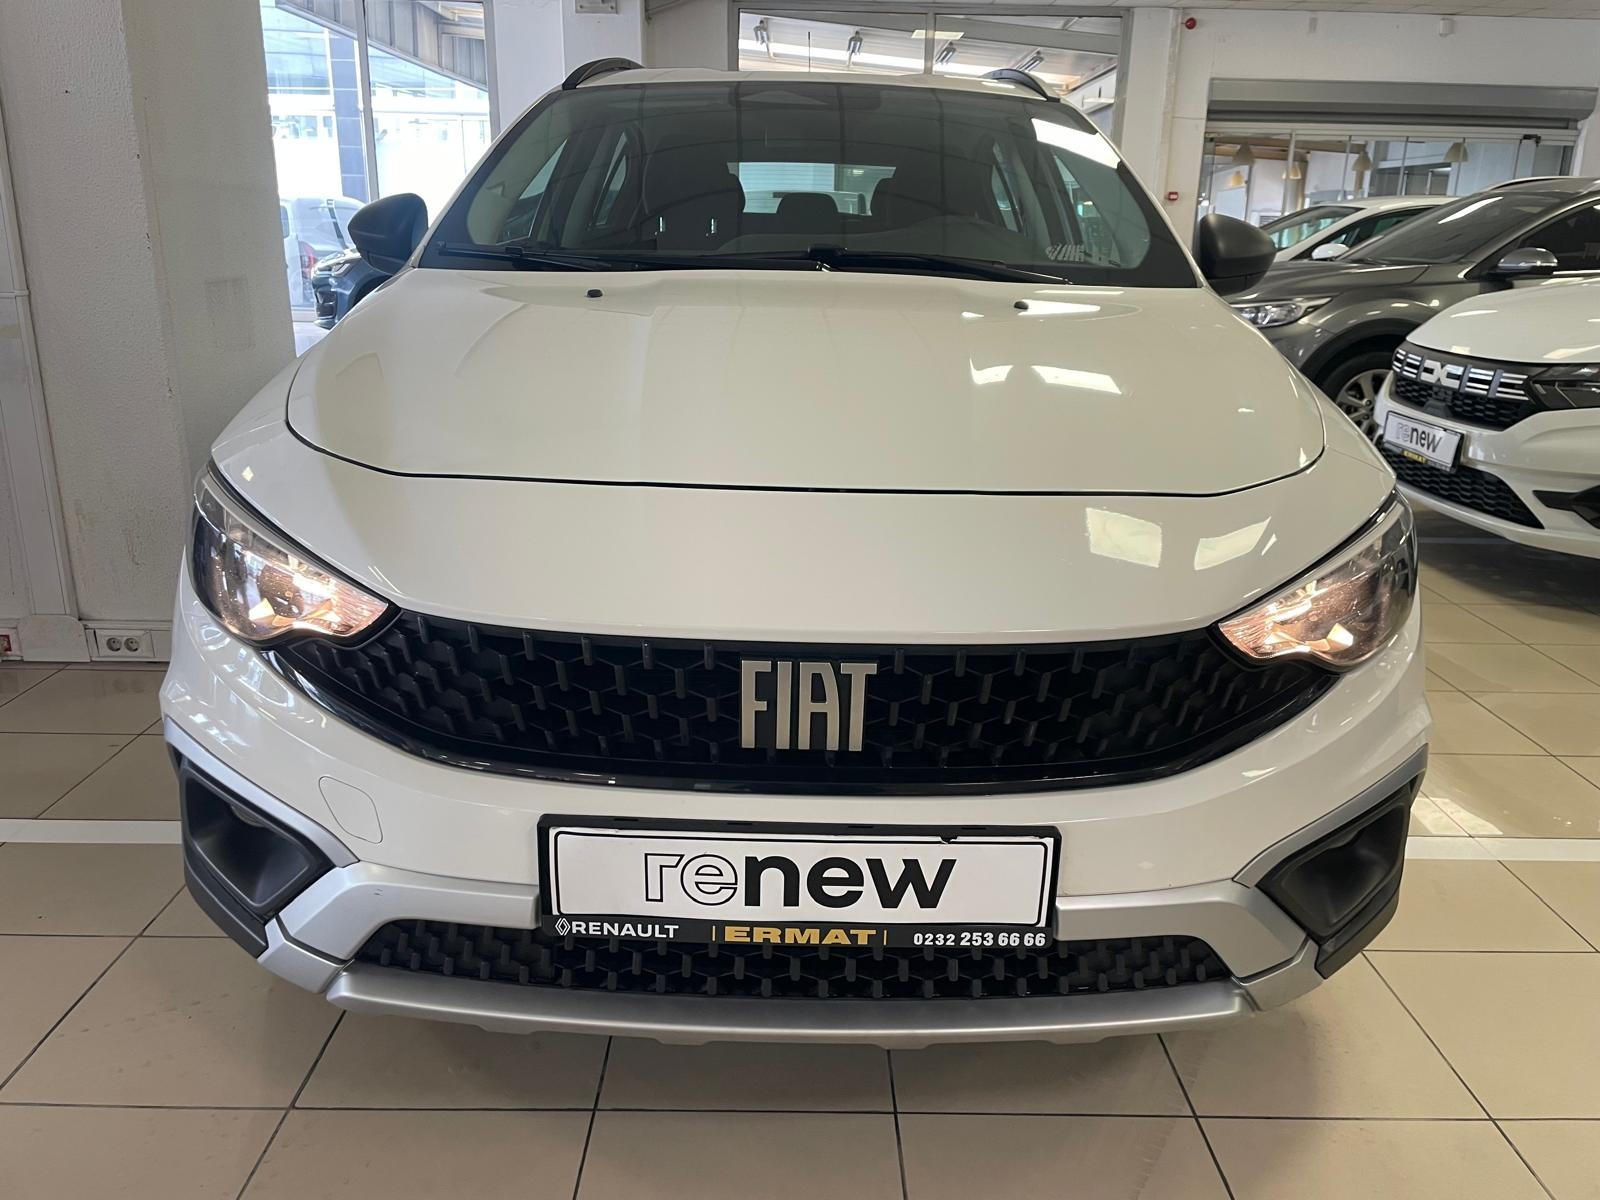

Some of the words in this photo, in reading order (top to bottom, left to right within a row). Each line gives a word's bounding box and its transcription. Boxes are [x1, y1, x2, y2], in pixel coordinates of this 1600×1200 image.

[1396, 422, 1443, 453] renew
[741, 660, 877, 751] FIAT
[644, 853, 957, 908] renew
[571, 921, 679, 938] RENAULT
[724, 926, 876, 945] ERMAT
[913, 932, 955, 946] 0232
[960, 931, 994, 946] 253
[998, 932, 1020, 946] 66
[1023, 932, 1046, 946] 66
